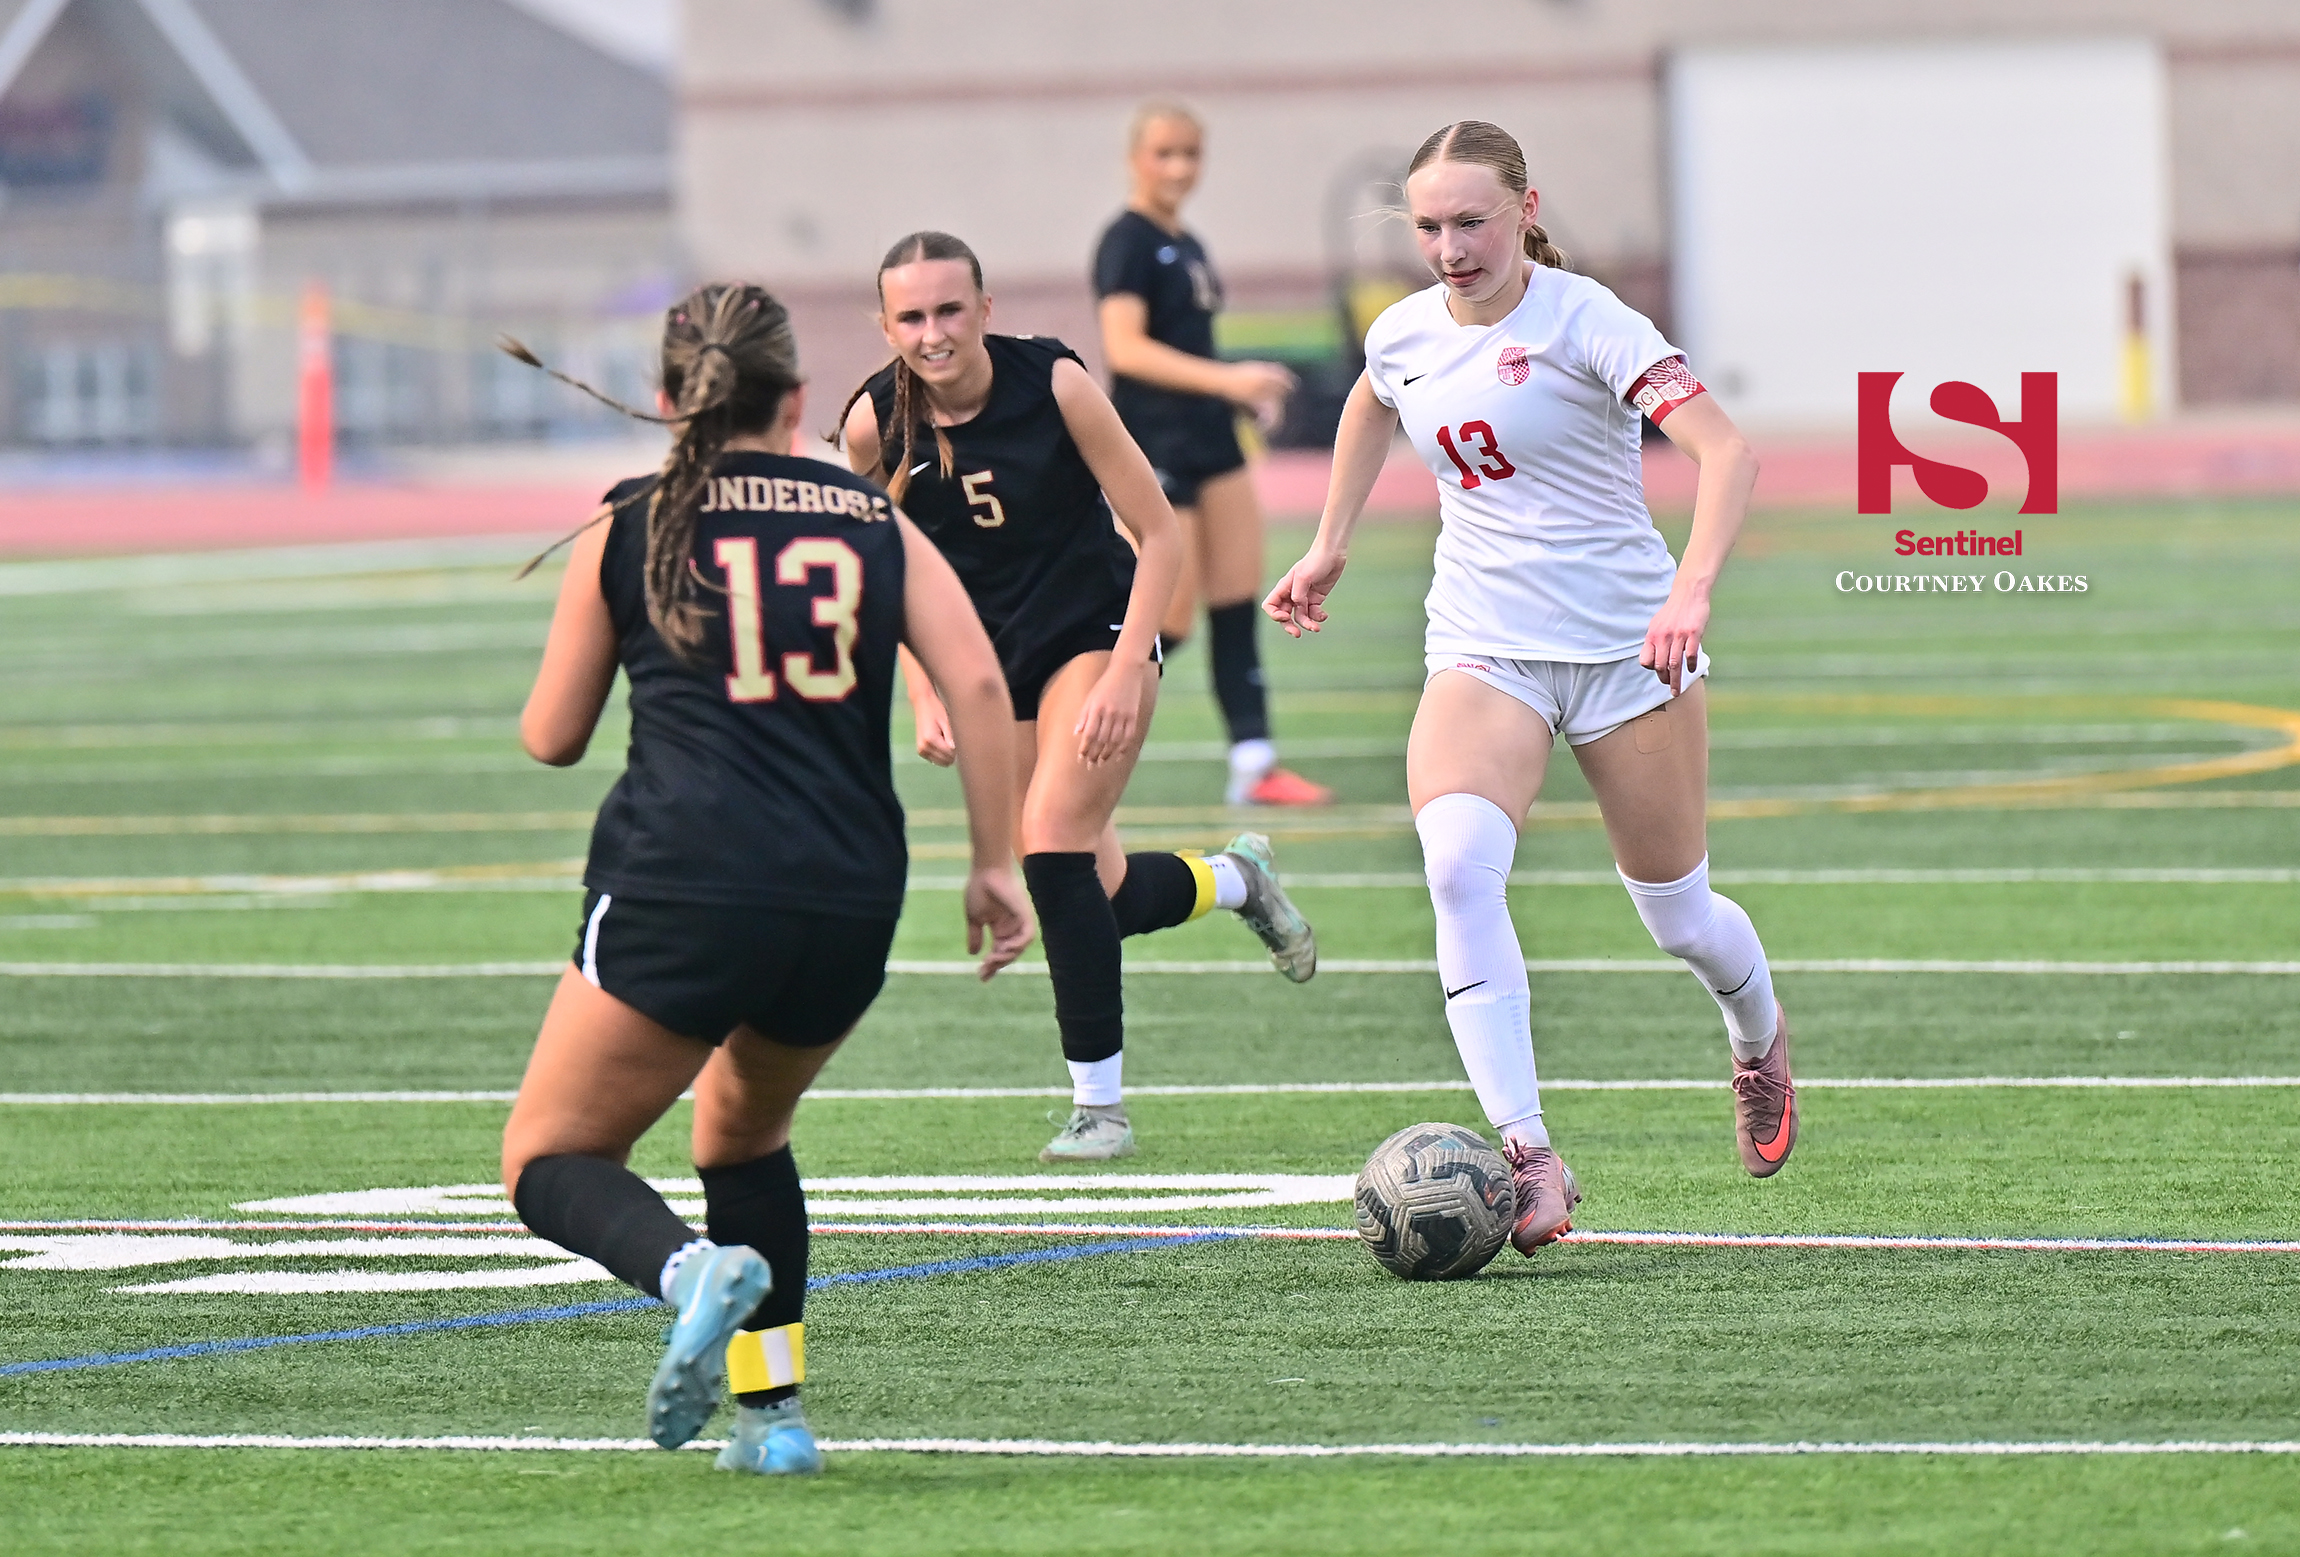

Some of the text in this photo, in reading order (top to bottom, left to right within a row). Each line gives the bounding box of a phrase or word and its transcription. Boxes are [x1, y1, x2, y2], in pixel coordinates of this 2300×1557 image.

[1436, 419, 1516, 490] 13
[961, 470, 1006, 528] 5
[713, 536, 864, 704] 13
